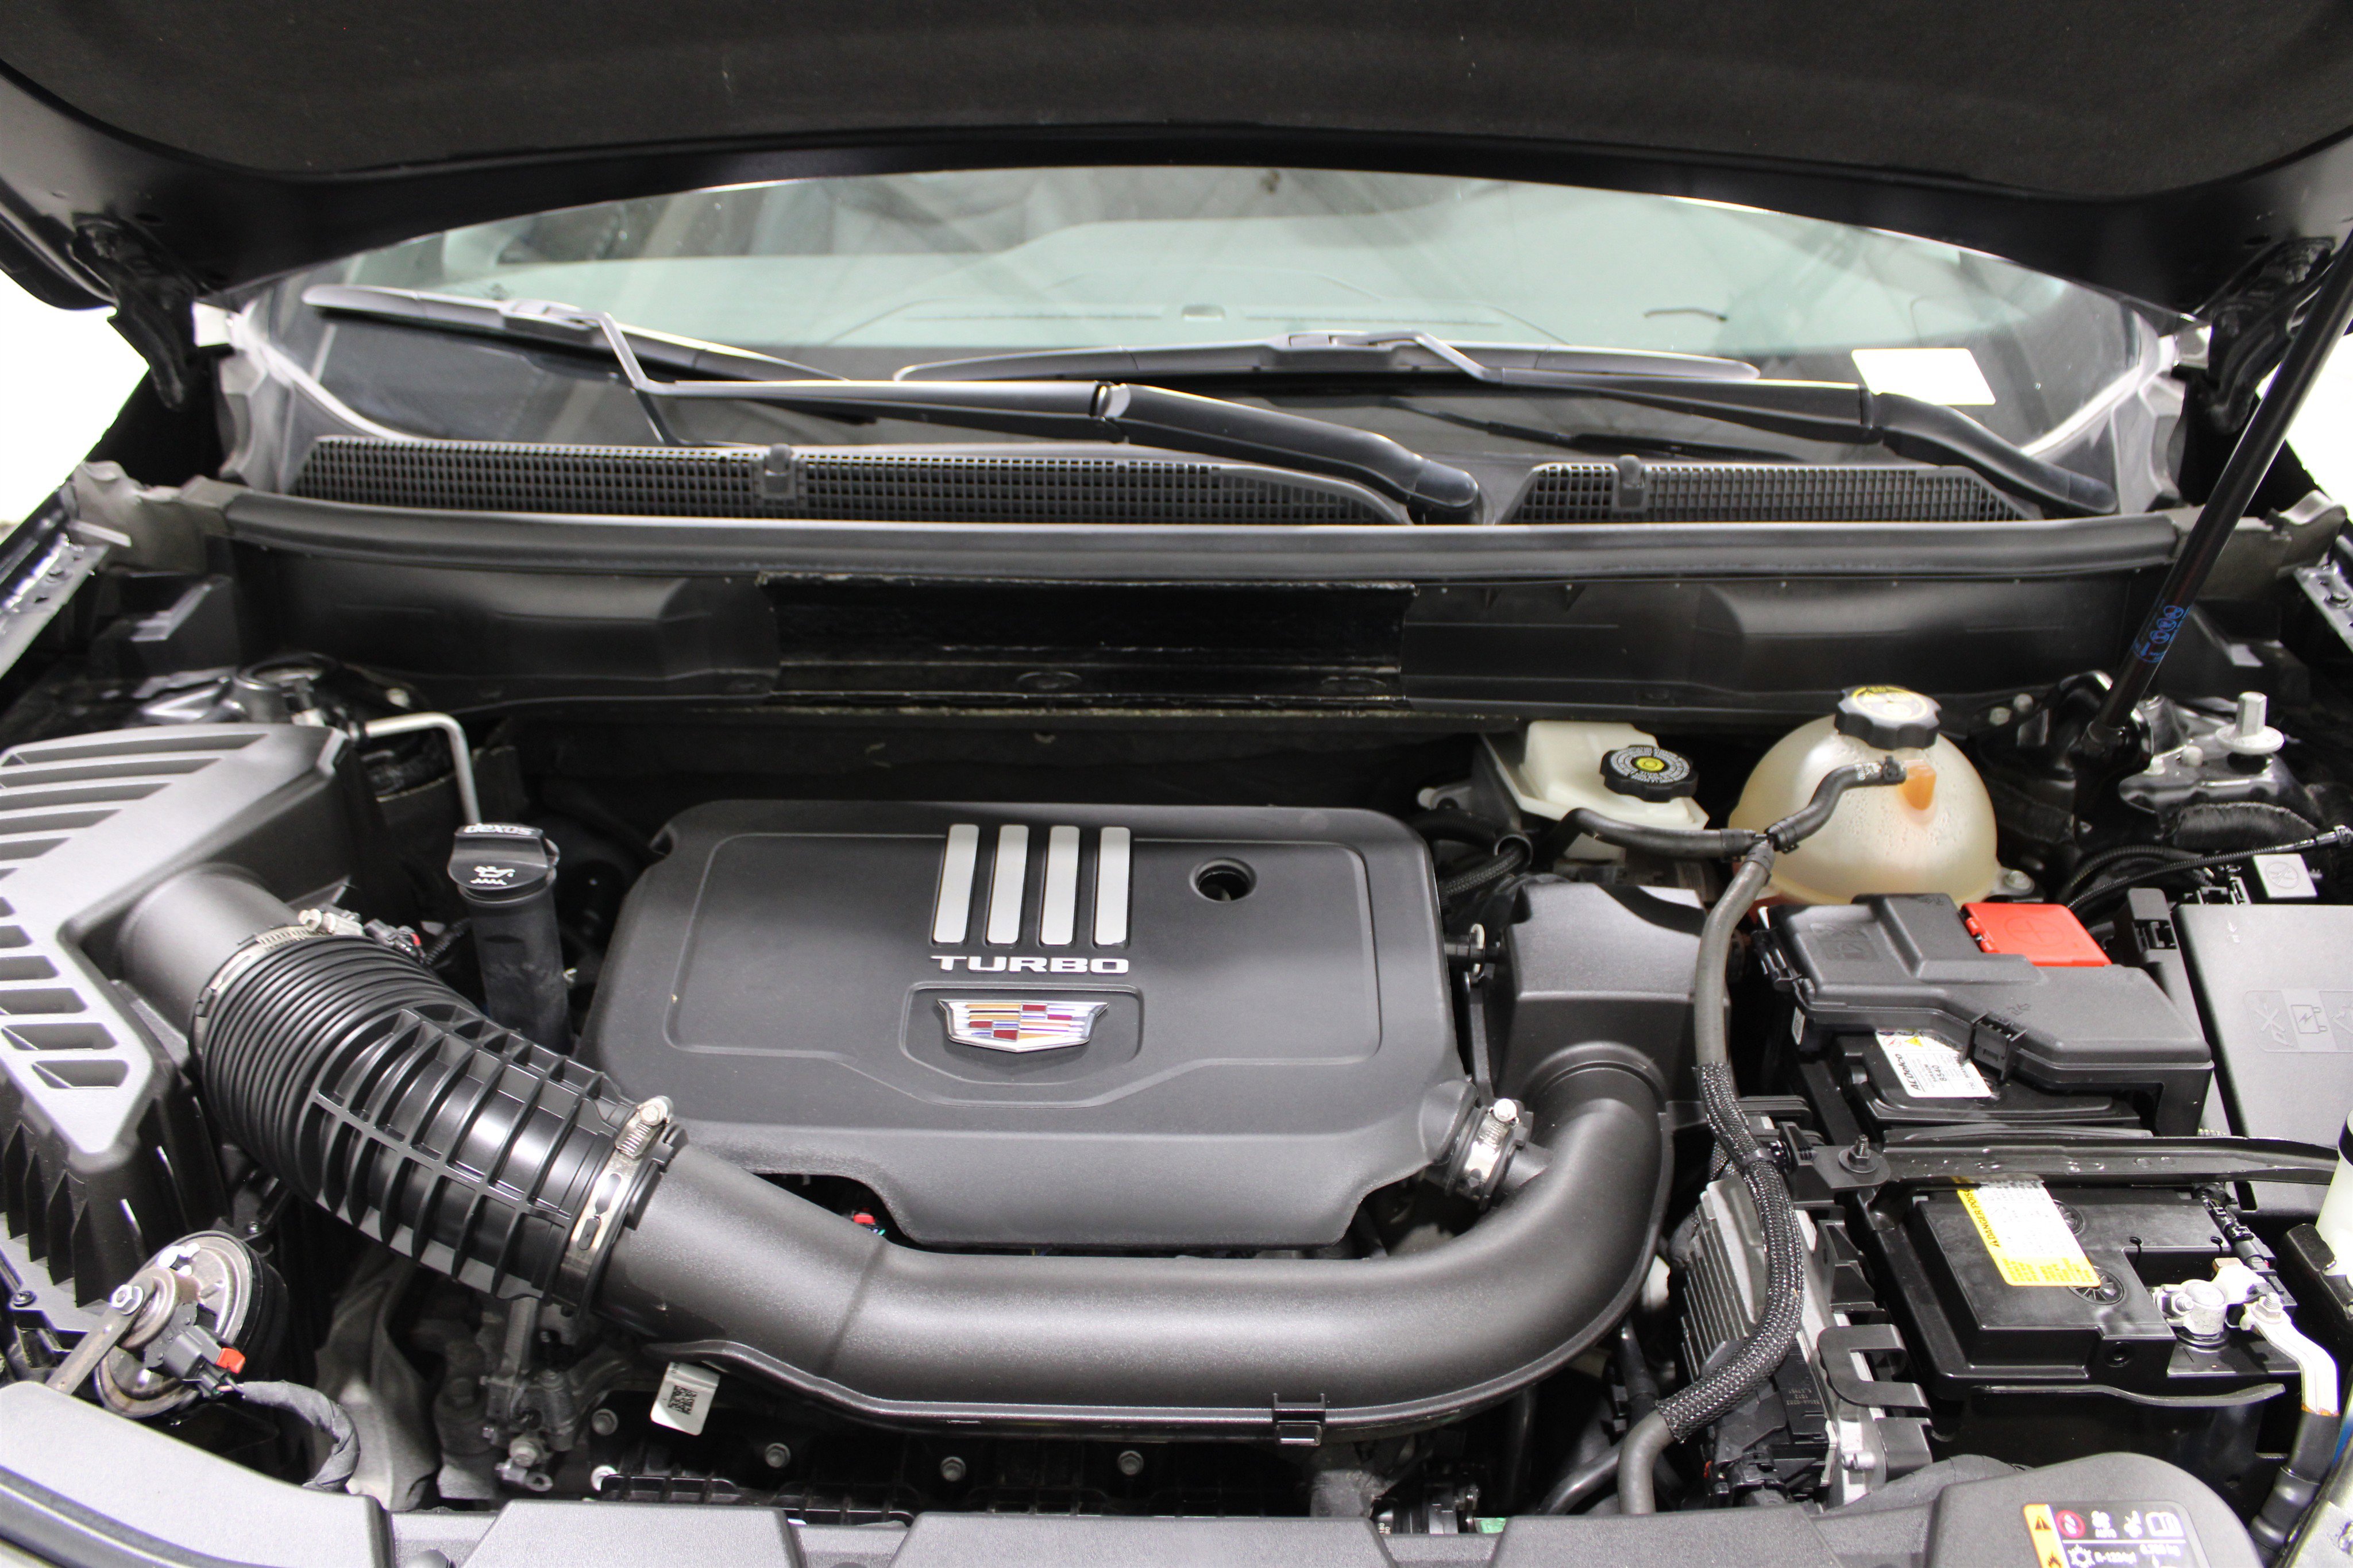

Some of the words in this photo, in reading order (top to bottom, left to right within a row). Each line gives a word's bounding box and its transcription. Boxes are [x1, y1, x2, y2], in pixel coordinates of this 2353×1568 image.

[464, 822, 535, 836] dexos
[930, 955, 1129, 974] TURBO
[1895, 1053, 1922, 1091] ACDelco
[1932, 1065, 1947, 1082] 8540
[1974, 1210, 1996, 1236] DANGER
